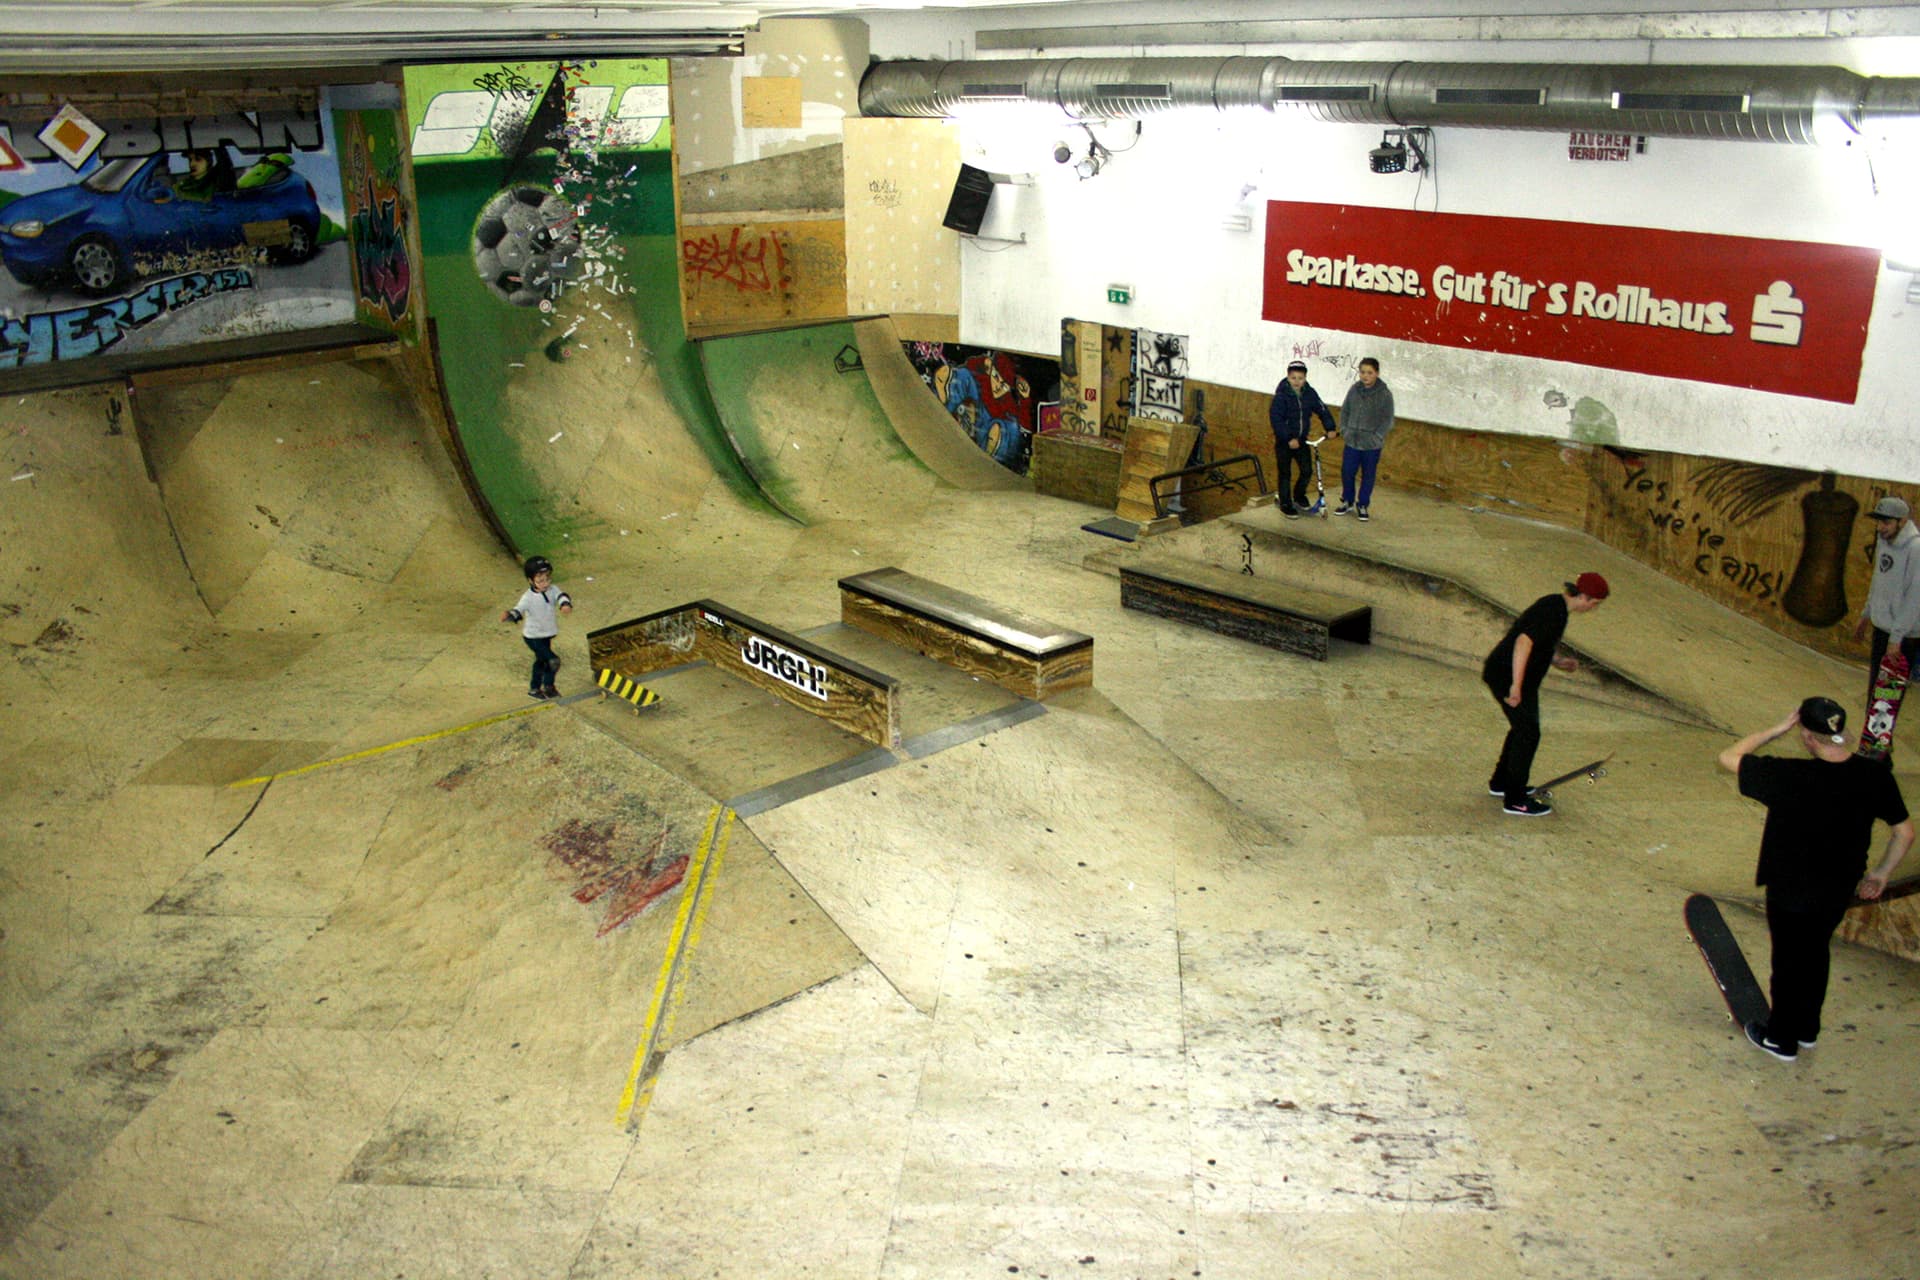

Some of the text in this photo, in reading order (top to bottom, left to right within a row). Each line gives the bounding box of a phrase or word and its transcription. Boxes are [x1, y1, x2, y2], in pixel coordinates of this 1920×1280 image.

[1568, 146, 1630, 161] VERBOTEN!
[1569, 132, 1631, 148] RAUCHEN
[1286, 249, 1427, 298] Sparkasse.
[1432, 265, 1487, 305] Gut
[1572, 281, 1735, 335] Rollhaus.
[1146, 379, 1180, 404] Exit
[1623, 466, 1680, 510] Yes,
[1648, 508, 1726, 550] we're
[1695, 554, 1784, 607] cans!
